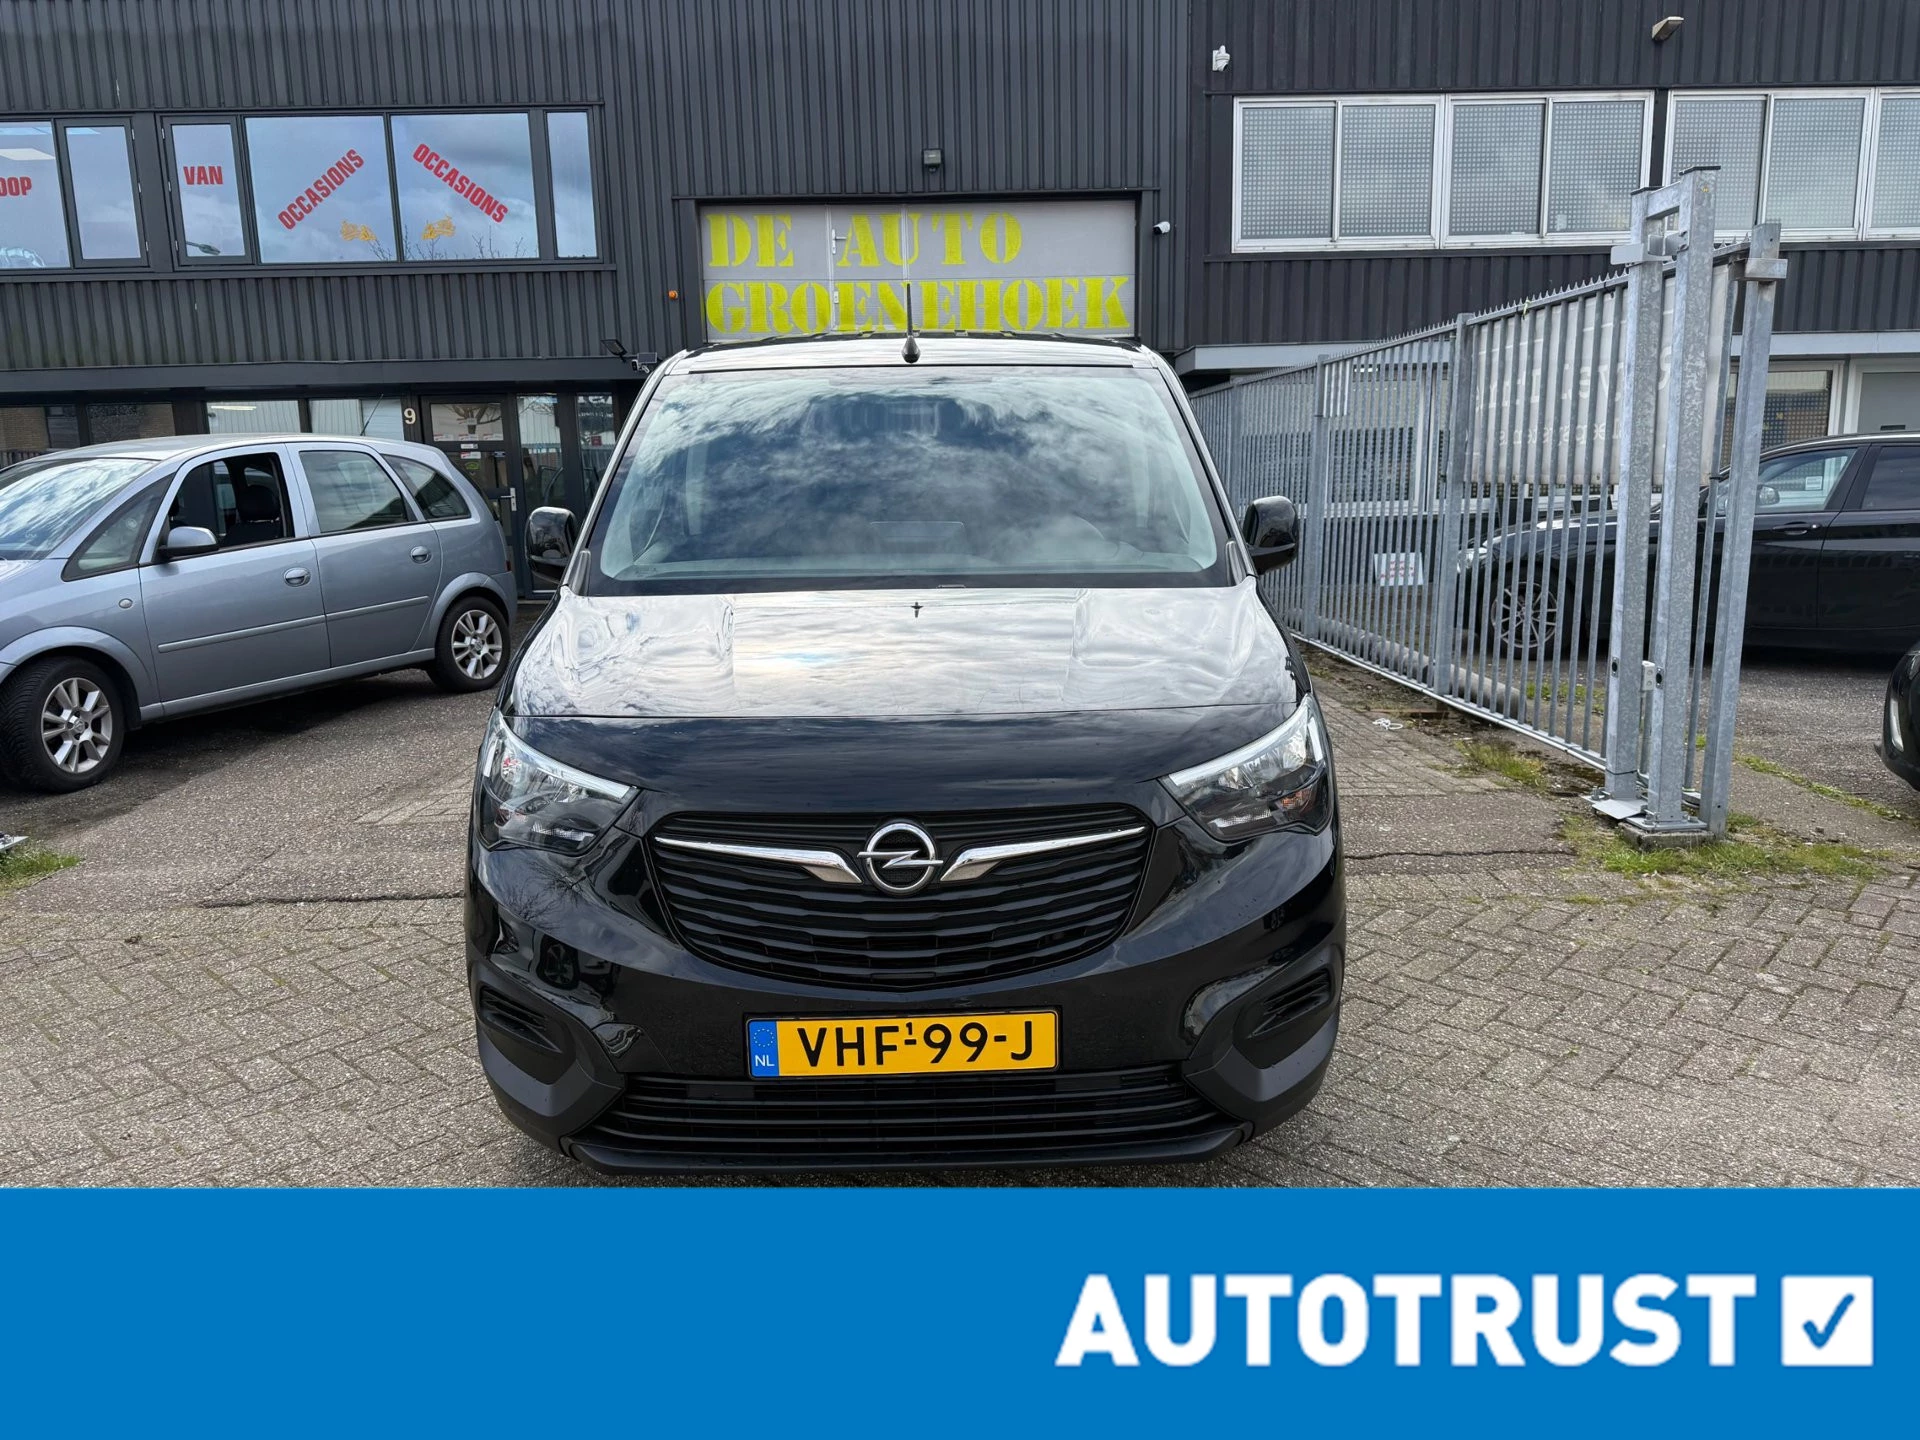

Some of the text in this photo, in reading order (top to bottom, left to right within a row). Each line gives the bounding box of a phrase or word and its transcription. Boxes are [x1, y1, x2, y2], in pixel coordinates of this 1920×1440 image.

[183, 165, 223, 185] VAN
[277, 148, 364, 230] OCCASIONS
[412, 143, 508, 223] OCCASIONS
[706, 211, 1022, 267] DE AUTO
[706, 275, 1130, 334] GROENEHOEK
[403, 407, 416, 424] 9
[755, 1054, 775, 1067] NL
